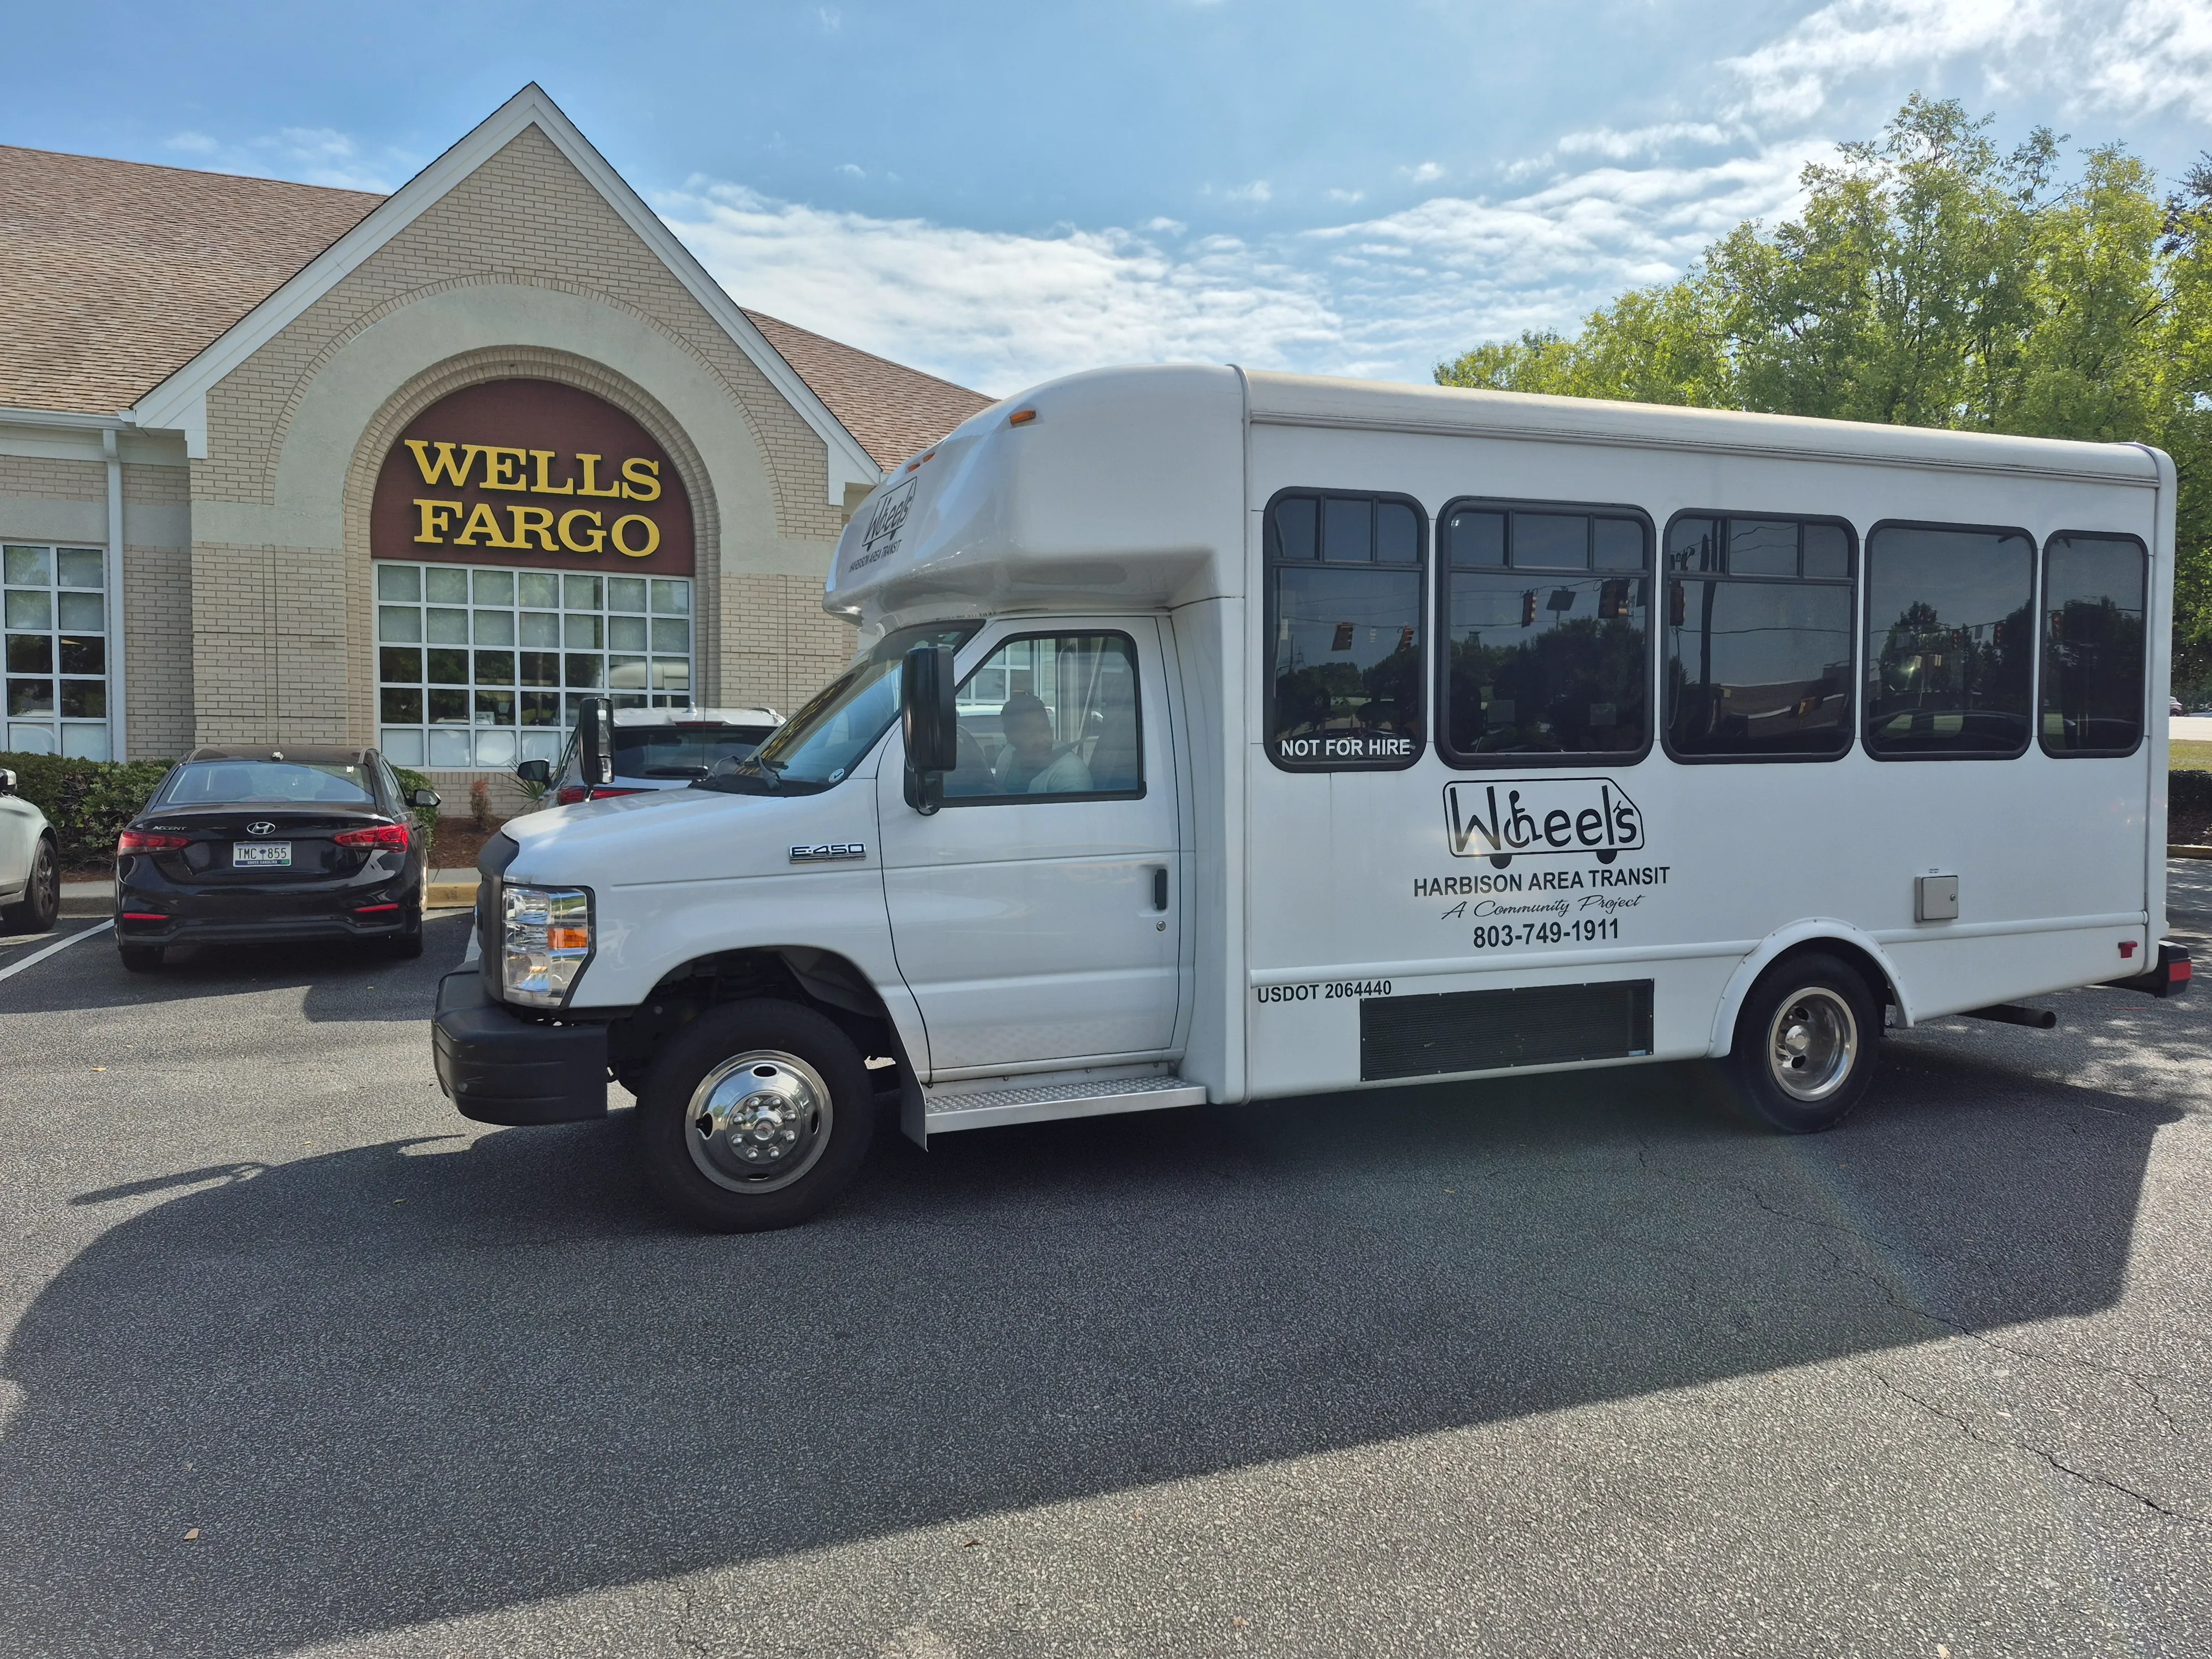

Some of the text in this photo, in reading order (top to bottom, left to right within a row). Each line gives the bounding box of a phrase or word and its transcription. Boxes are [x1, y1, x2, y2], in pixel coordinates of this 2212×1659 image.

[404, 439, 661, 502] WELLS
[864, 482, 914, 543] Wheels
[413, 499, 660, 557] FARGO
[848, 539, 902, 573] HARBISON AREA TRANSIT
[1281, 739, 1411, 757] NOT FOR HIRE
[1449, 785, 1637, 852] Wheels
[237, 848, 286, 859] TMC 855
[1414, 867, 1670, 897] HARBISON AREA TRANSIT
[1441, 894, 1646, 919] A Community Project
[1473, 918, 1618, 948] 803-749-1911
[1258, 980, 1392, 1003] USDOT 2064440
